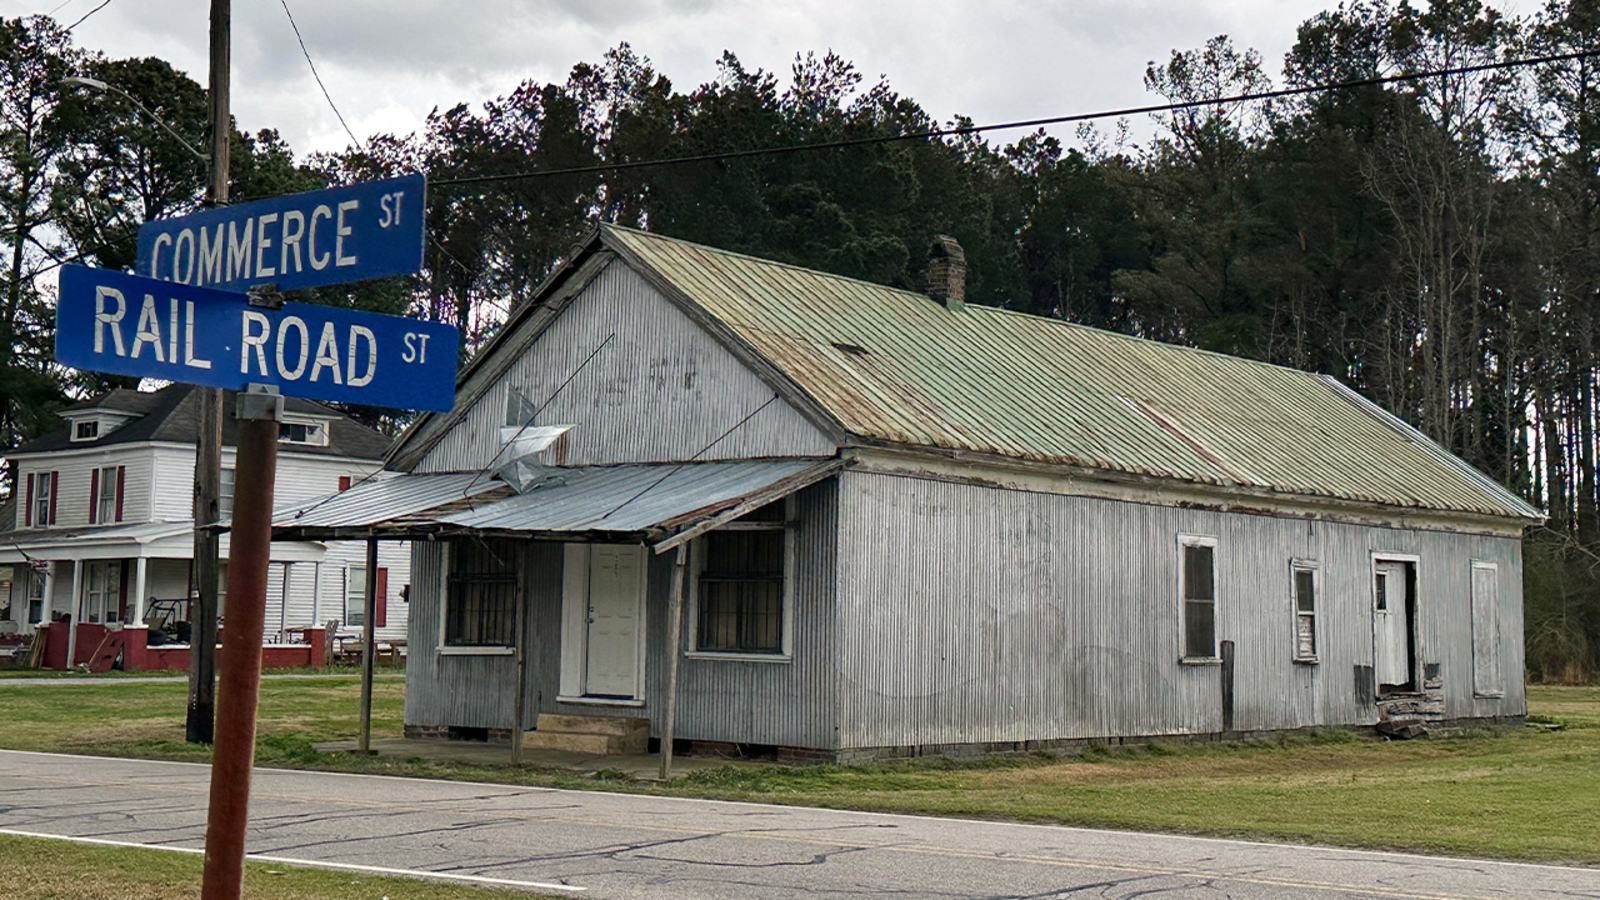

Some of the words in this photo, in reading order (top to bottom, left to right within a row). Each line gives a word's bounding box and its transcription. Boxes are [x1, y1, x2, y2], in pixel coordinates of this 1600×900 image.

[151, 200, 359, 286] COMMERCE
[379, 191, 404, 228] ST
[94, 285, 212, 370] RAIL
[240, 310, 377, 387] ROAD
[401, 332, 431, 364] ST
